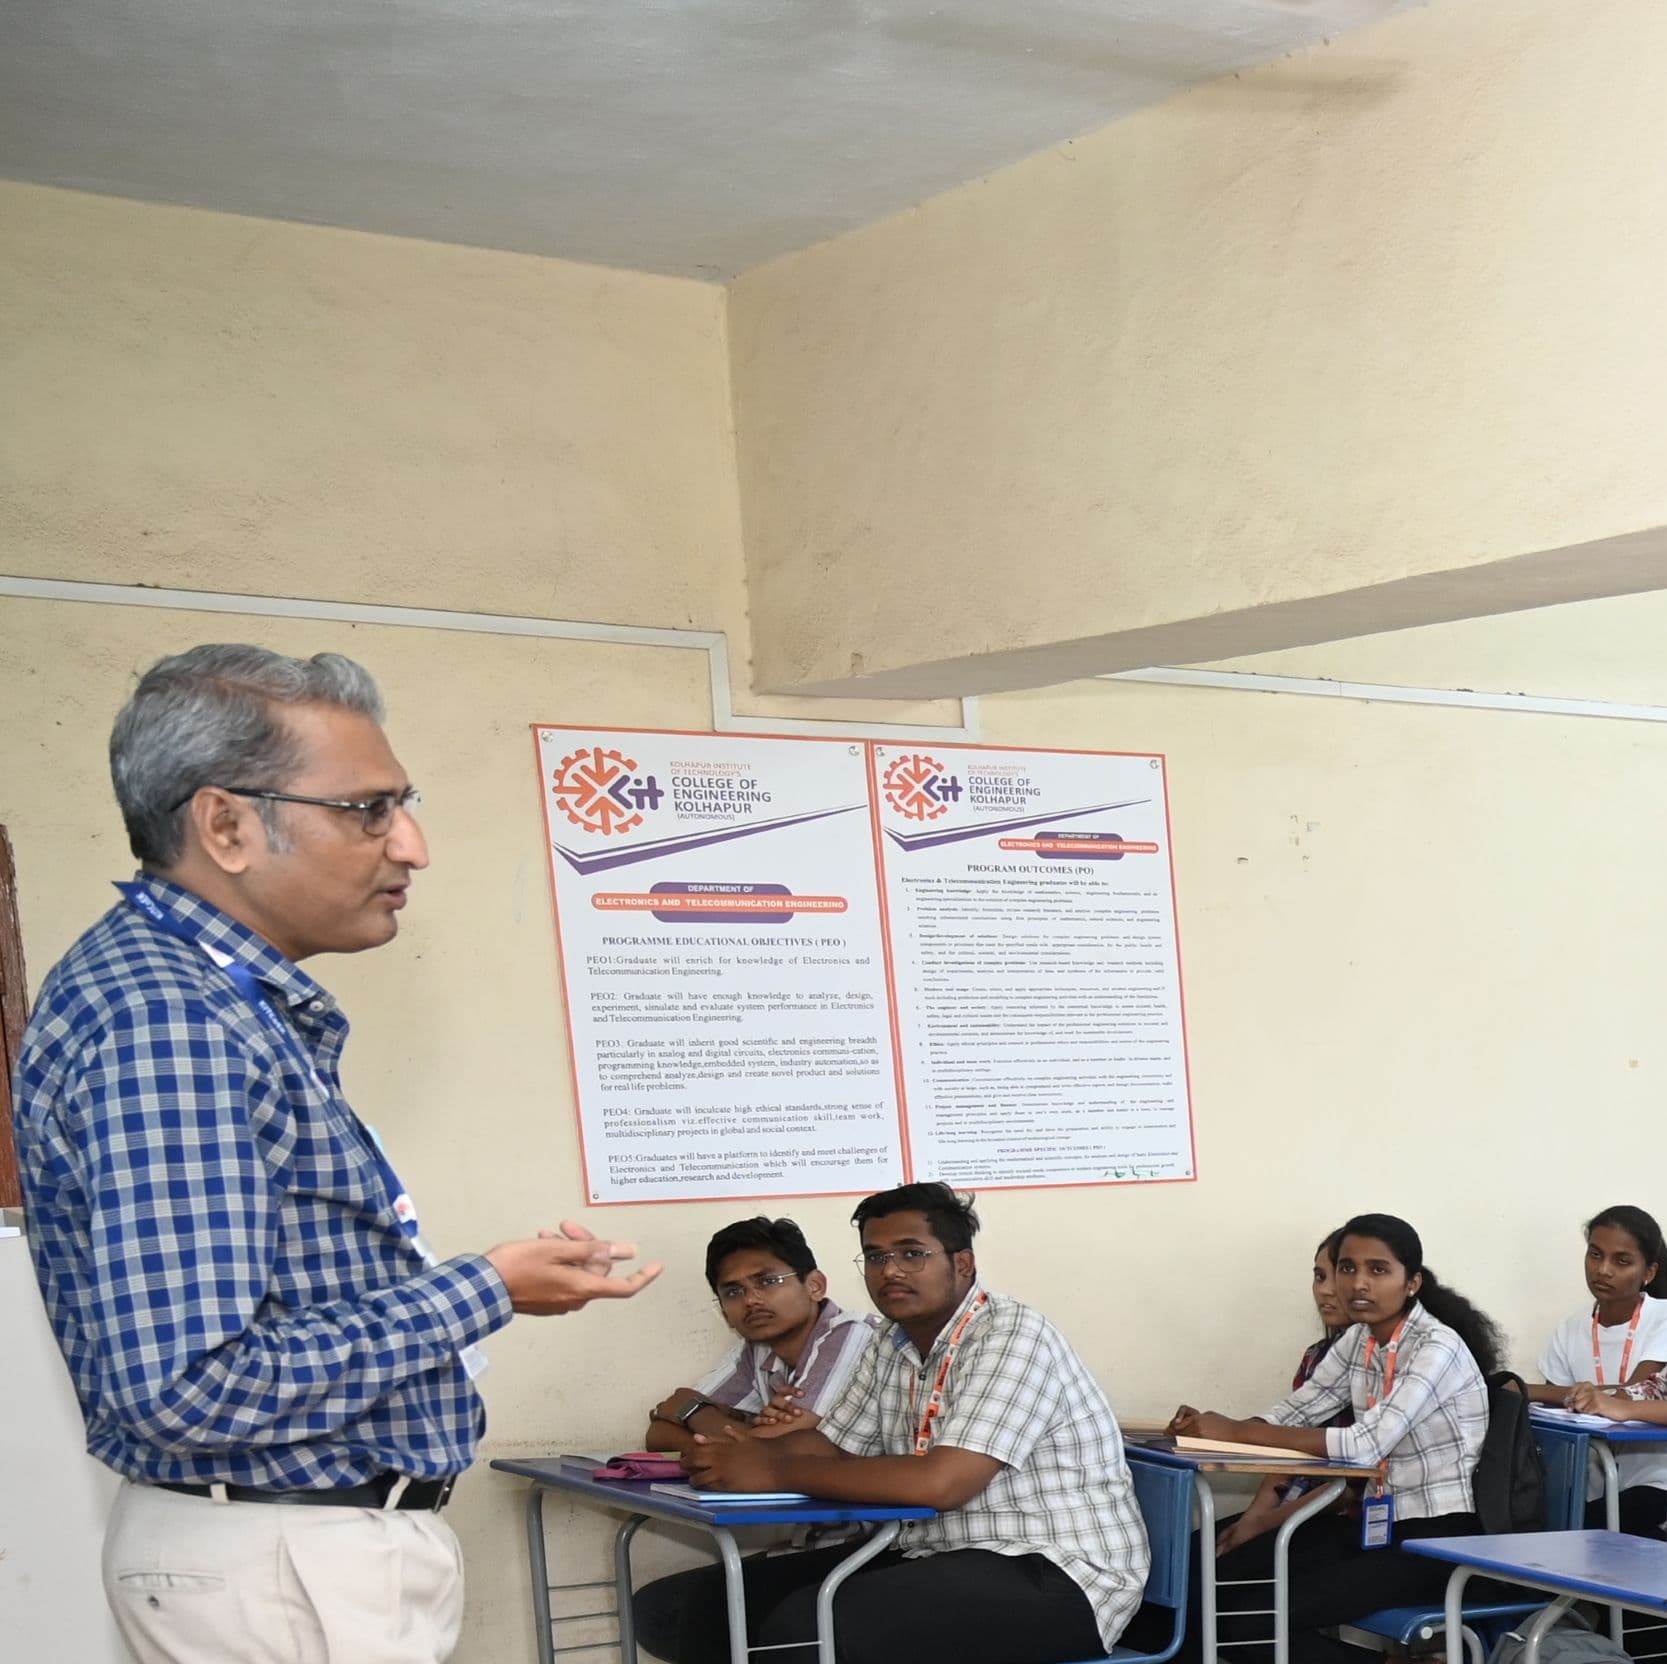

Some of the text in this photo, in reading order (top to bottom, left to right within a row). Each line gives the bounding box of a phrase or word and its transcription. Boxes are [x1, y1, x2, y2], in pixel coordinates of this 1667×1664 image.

[670, 761, 711, 770] KOLHAPUR
[670, 768, 678, 776] OF
[672, 777, 758, 790] COLLEGE OF
[968, 776, 1031, 787] COLLEGE OF
[673, 789, 772, 803] ENGINEERING
[969, 786, 1041, 796] ENGINEERING
[970, 795, 1027, 805] KOLHAPUR
[674, 800, 753, 814] KOLHAPUR
[677, 813, 736, 821] (AUTONOMOUS)
[967, 864, 1095, 876] PROGRAM OUTCOMES (PO)
[688, 885, 755, 893] DEPARTMENT OF
[595, 898, 845, 910] ELECTRONICS AND TELECOMMUNICATION ENGINEERING
[602, 936, 841, 946] PROGRAMME EDUCATIONAL OBJECTIVES PEO
[663, 956, 680, 964] will
[685, 956, 713, 964] enrich
[718, 956, 731, 964] for
[736, 956, 783, 965] knowledge
[788, 956, 798, 964] of
[802, 956, 850, 964] Electronics
[855, 956, 870, 964] and
[587, 966, 671, 975] Telecommunication
[623, 992, 662, 1000] Graduate
[687, 992, 708, 1000] have
[712, 992, 742, 1001] enough
[746, 991, 791, 1000] knowledge
[808, 992, 841, 1000] analyze,
[591, 1004, 641, 1012] experiment,
[644, 1003, 679, 1011] simulate
[682, 1002, 697, 1010] and
[736, 1003, 765, 1011] system
[830, 1001, 874, 1009] Electronics
[592, 1014, 608, 1022] and
[608, 1014, 691, 1022] Telecommunication
[626, 1039, 665, 1047] Graduate
[668, 1038, 685, 1046] will
[718, 1038, 739, 1047] good
[742, 1037, 778, 1045] scientific
[781, 1037, 796, 1045] and
[798, 1038, 845, 1046] engineering
[848, 1036, 877, 1044] breadth
[596, 1050, 644, 1060] particularly
[658, 1050, 686, 1059] analog
[687, 1049, 703, 1057] and
[704, 1049, 731, 1058] digital
[767, 1048, 811, 1056] electronics
[598, 1062, 655, 1071] programming
[747, 1060, 778, 1068] system,
[780, 1058, 812, 1067] industry
[610, 1071, 662, 1081] comprehend
[795, 1069, 826, 1077] product
[828, 1068, 843, 1076] and
[600, 1083, 613, 1091] for
[613, 1082, 630, 1091] real
[630, 1082, 645, 1090] life
[633, 1107, 672, 1115] Graduate
[675, 1106, 691, 1114] will
[734, 1104, 752, 1114] high
[755, 1104, 782, 1112] ethical
[874, 1101, 884, 1109] of
[604, 1118, 676, 1128] professionalism
[742, 1115, 808, 1123] communication
[605, 1129, 675, 1139] multidisciplinary
[677, 1129, 709, 1137] projects
[719, 1126, 745, 1136] global
[746, 1125, 761, 1133] and
[761, 1125, 785, 1133] social
[679, 1152, 695, 1160] will
[723, 1151, 758, 1160] platform
[769, 1148, 800, 1158] identify
[801, 1148, 816, 1156] and
[837, 1146, 878, 1155] challenges
[609, 1165, 656, 1173] Electronics
[660, 1163, 675, 1172] and
[678, 1162, 759, 1171] Telecommunication
[762, 1159, 787, 1167] which
[810, 1159, 850, 1167] encourage
[610, 1176, 637, 1186] higher
[715, 1172, 731, 1180] and
